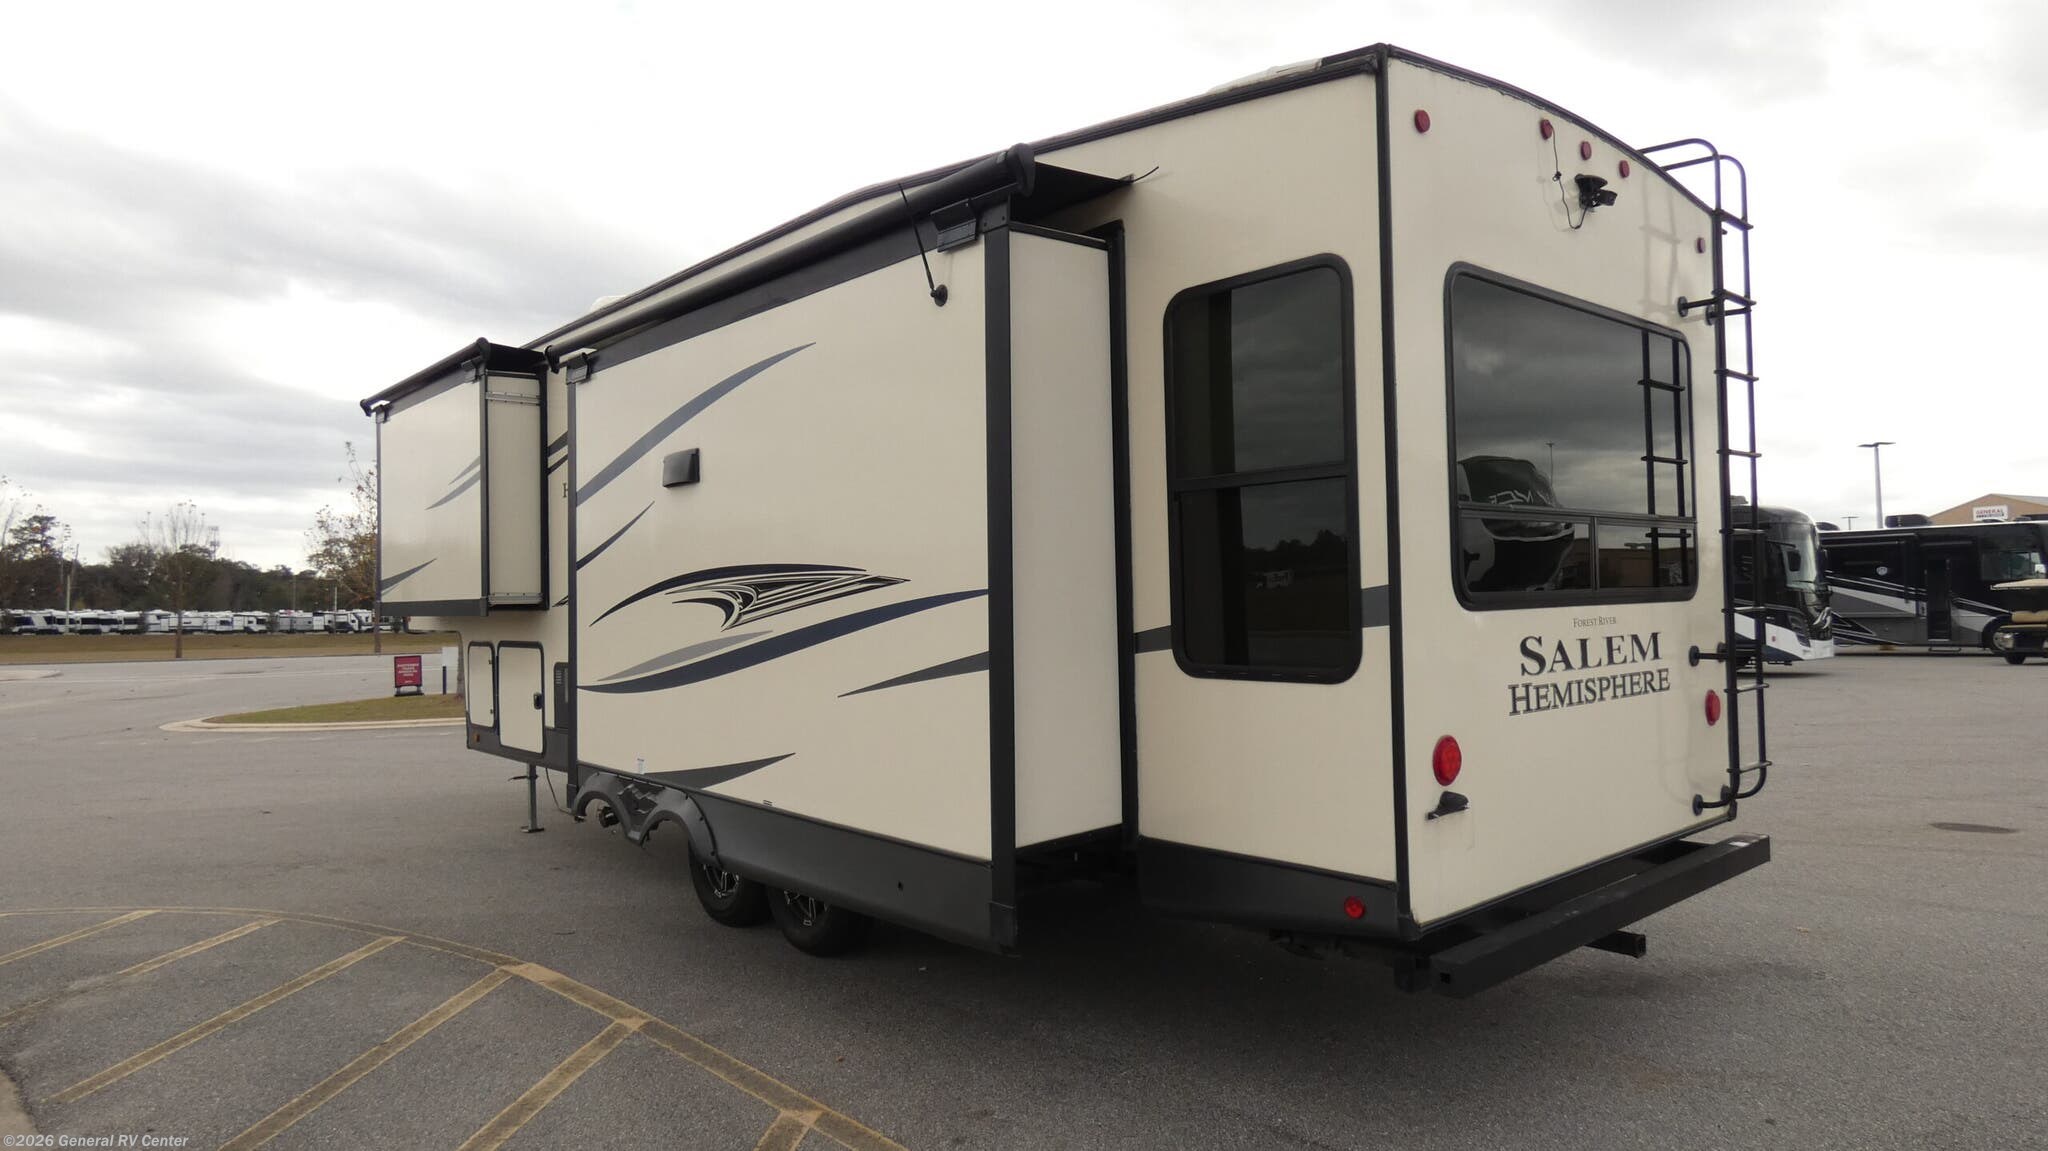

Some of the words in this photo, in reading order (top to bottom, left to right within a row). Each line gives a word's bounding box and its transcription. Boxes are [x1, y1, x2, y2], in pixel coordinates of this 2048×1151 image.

[1573, 617, 1597, 628] FOREST
[1598, 615, 1617, 625] RIVER
[1519, 631, 1663, 677] SALEM
[1508, 668, 1671, 717] HEMISPHERE
